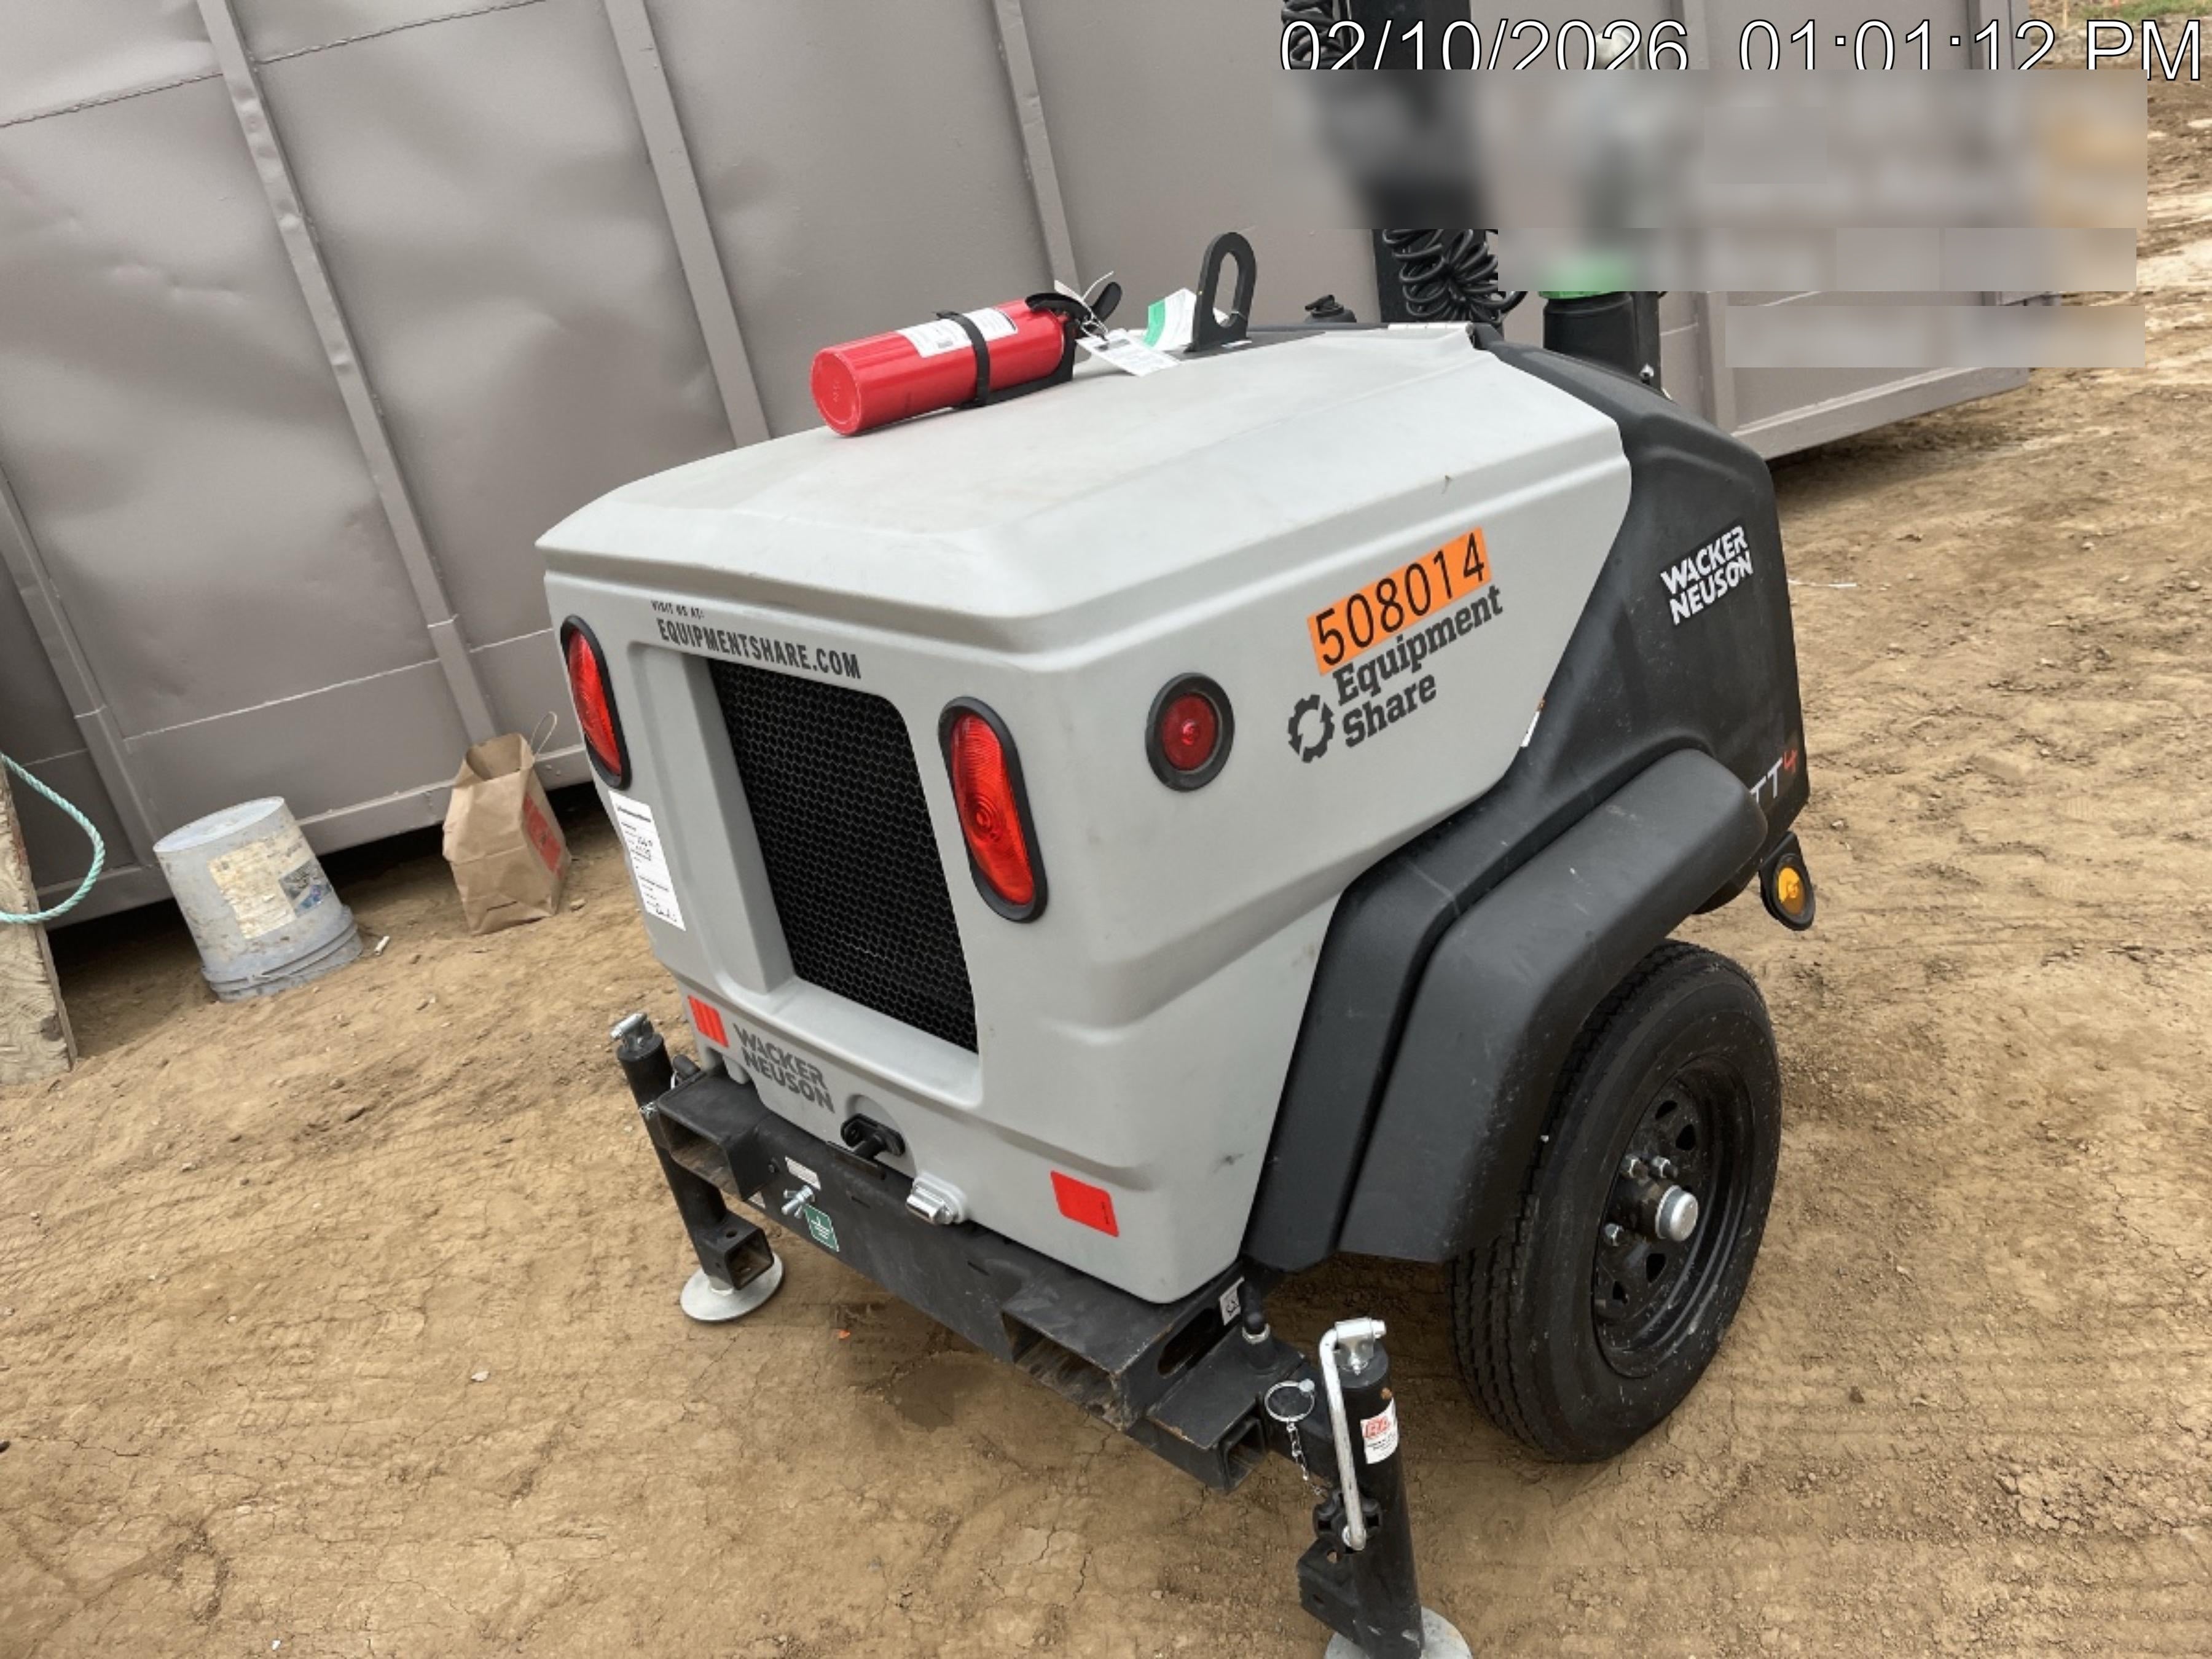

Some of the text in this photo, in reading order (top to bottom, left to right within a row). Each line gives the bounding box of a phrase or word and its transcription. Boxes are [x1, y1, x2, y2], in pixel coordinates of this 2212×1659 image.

[1660, 525, 1748, 595] WACKER
[1669, 551, 1753, 626] NEUSON
[1316, 532, 1484, 665] 508014
[656, 617, 861, 679] EQUIPMENTSHARE.COM
[1332, 584, 1503, 706] Equipment
[1343, 674, 1437, 748] Share
[733, 1022, 828, 1090] WACKER
[741, 1046, 835, 1113] NEUSON
